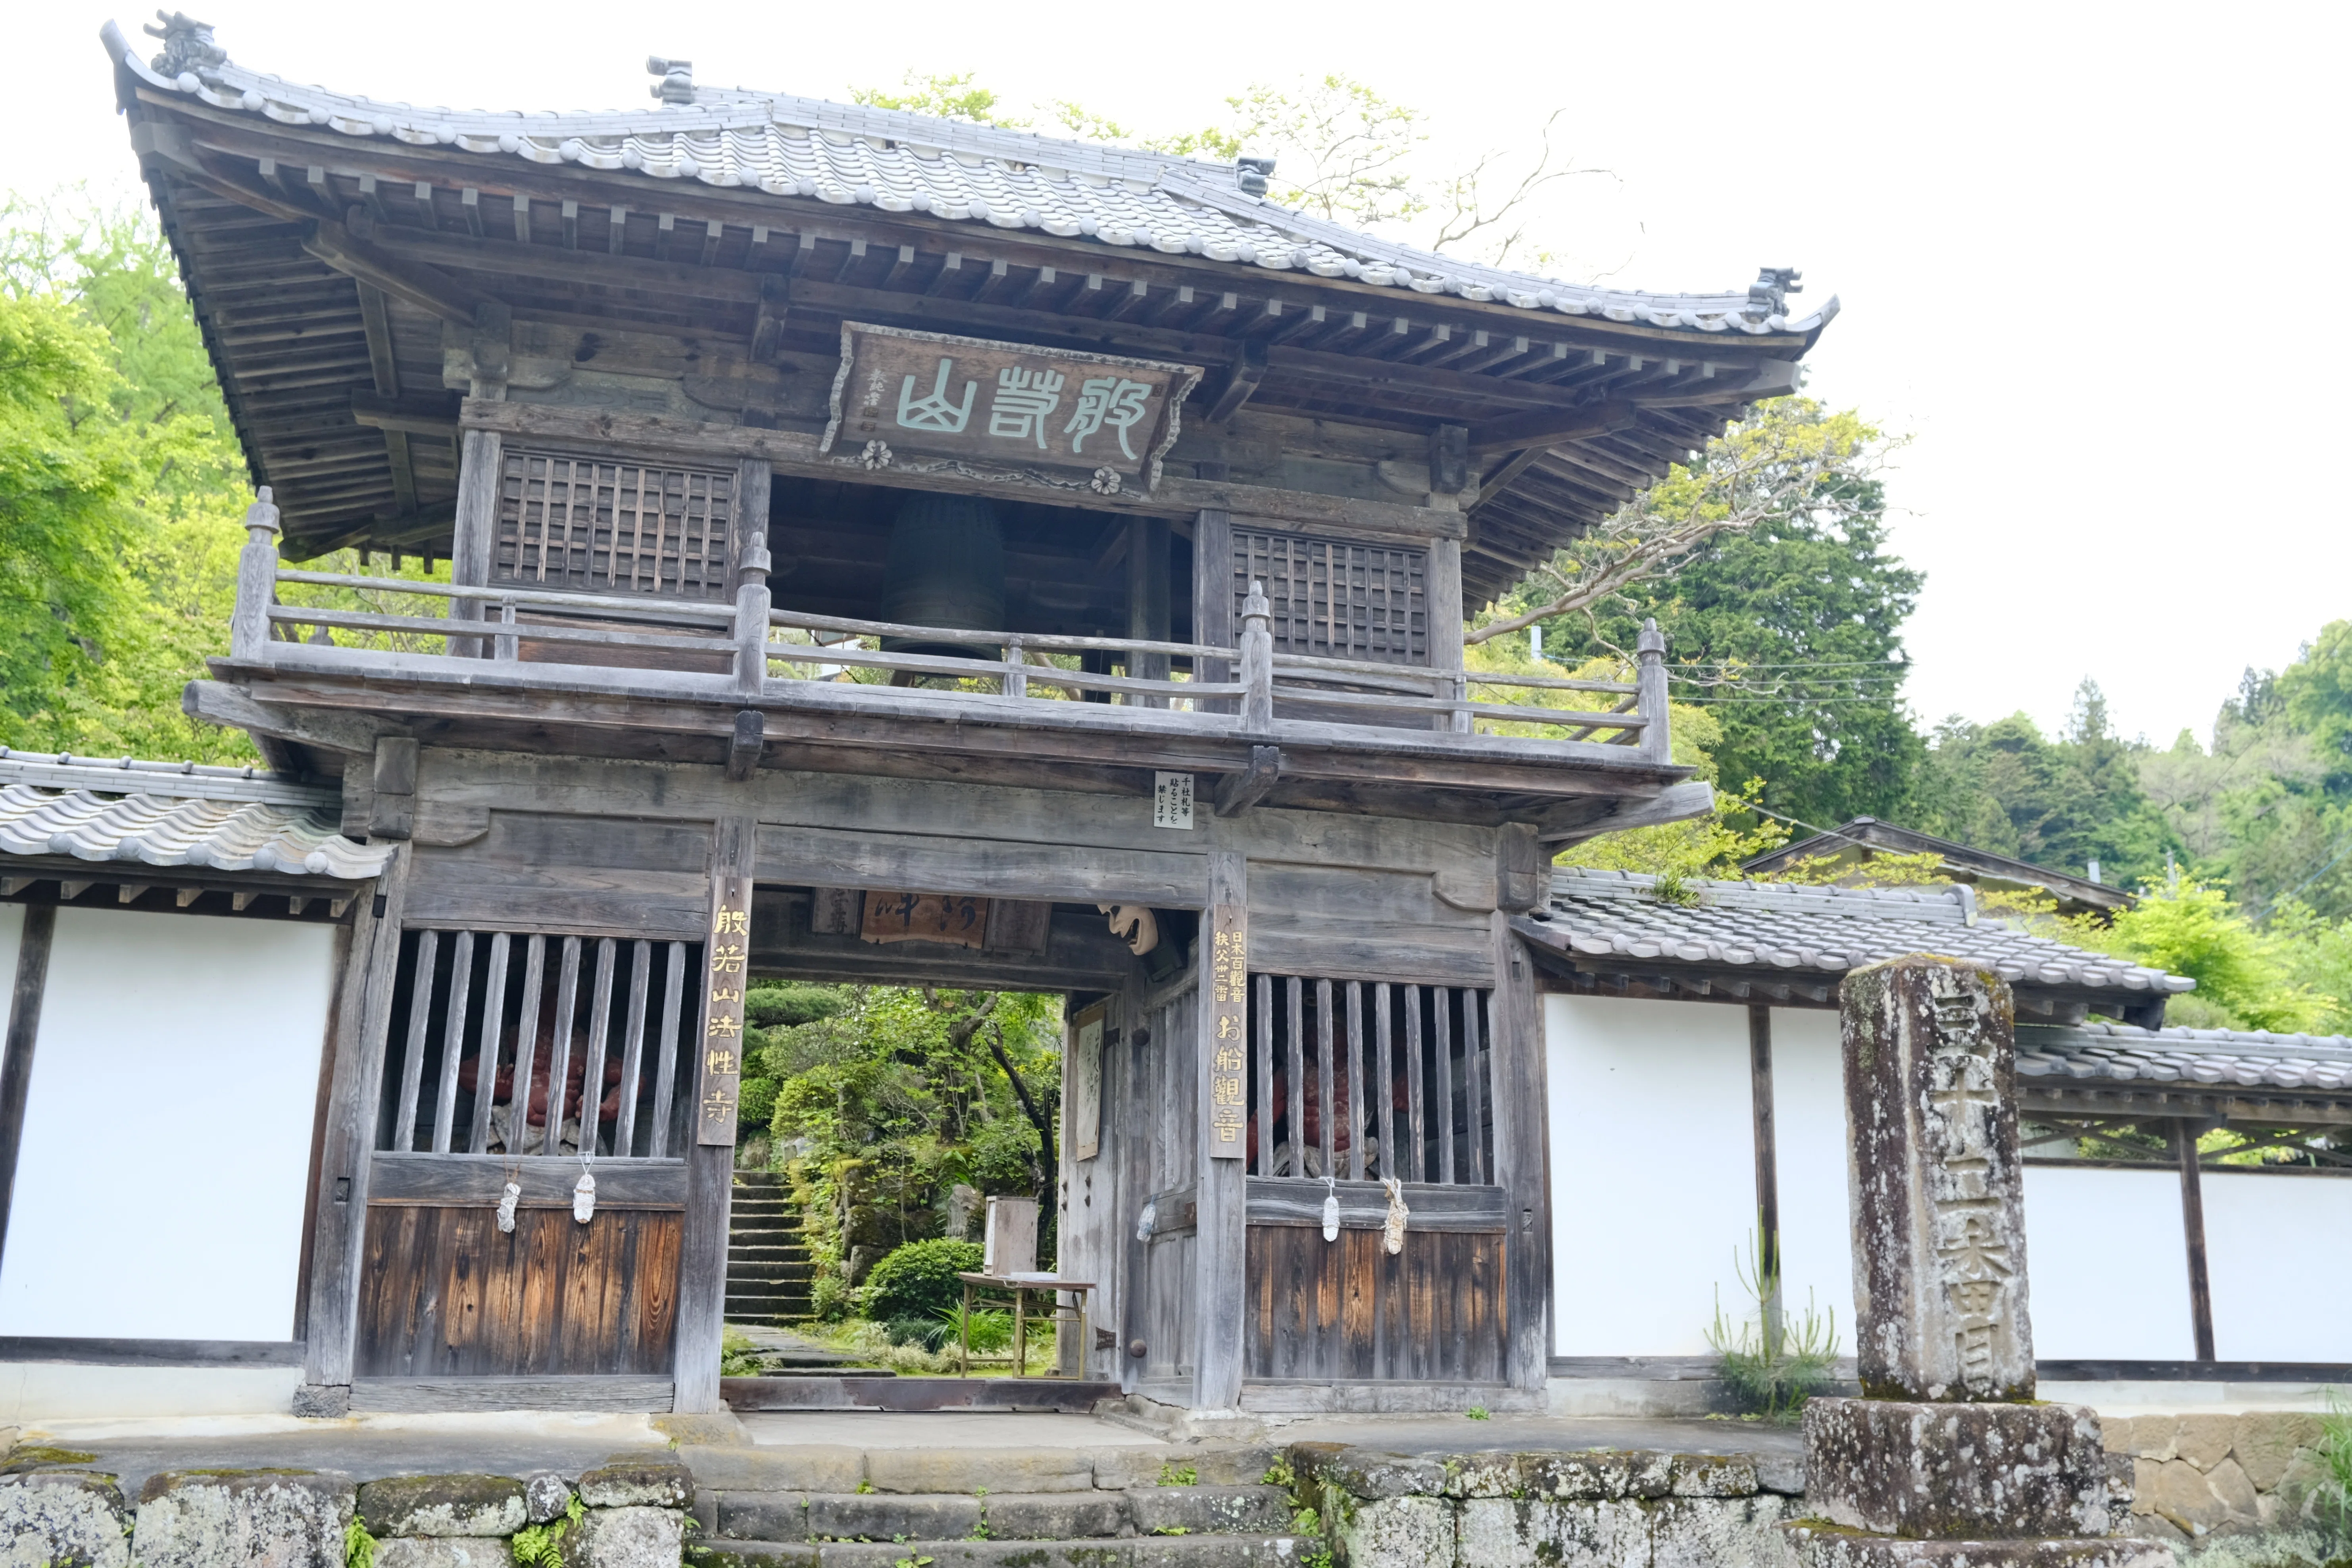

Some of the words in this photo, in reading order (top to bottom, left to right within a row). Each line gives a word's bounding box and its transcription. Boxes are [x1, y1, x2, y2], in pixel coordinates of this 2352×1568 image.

[1156, 784, 1166, 823] 禁じます
[1170, 778, 1179, 824] 貼ることを
[1181, 777, 1190, 817] 千社札等
[703, 904, 749, 1124] 般若山法性寺
